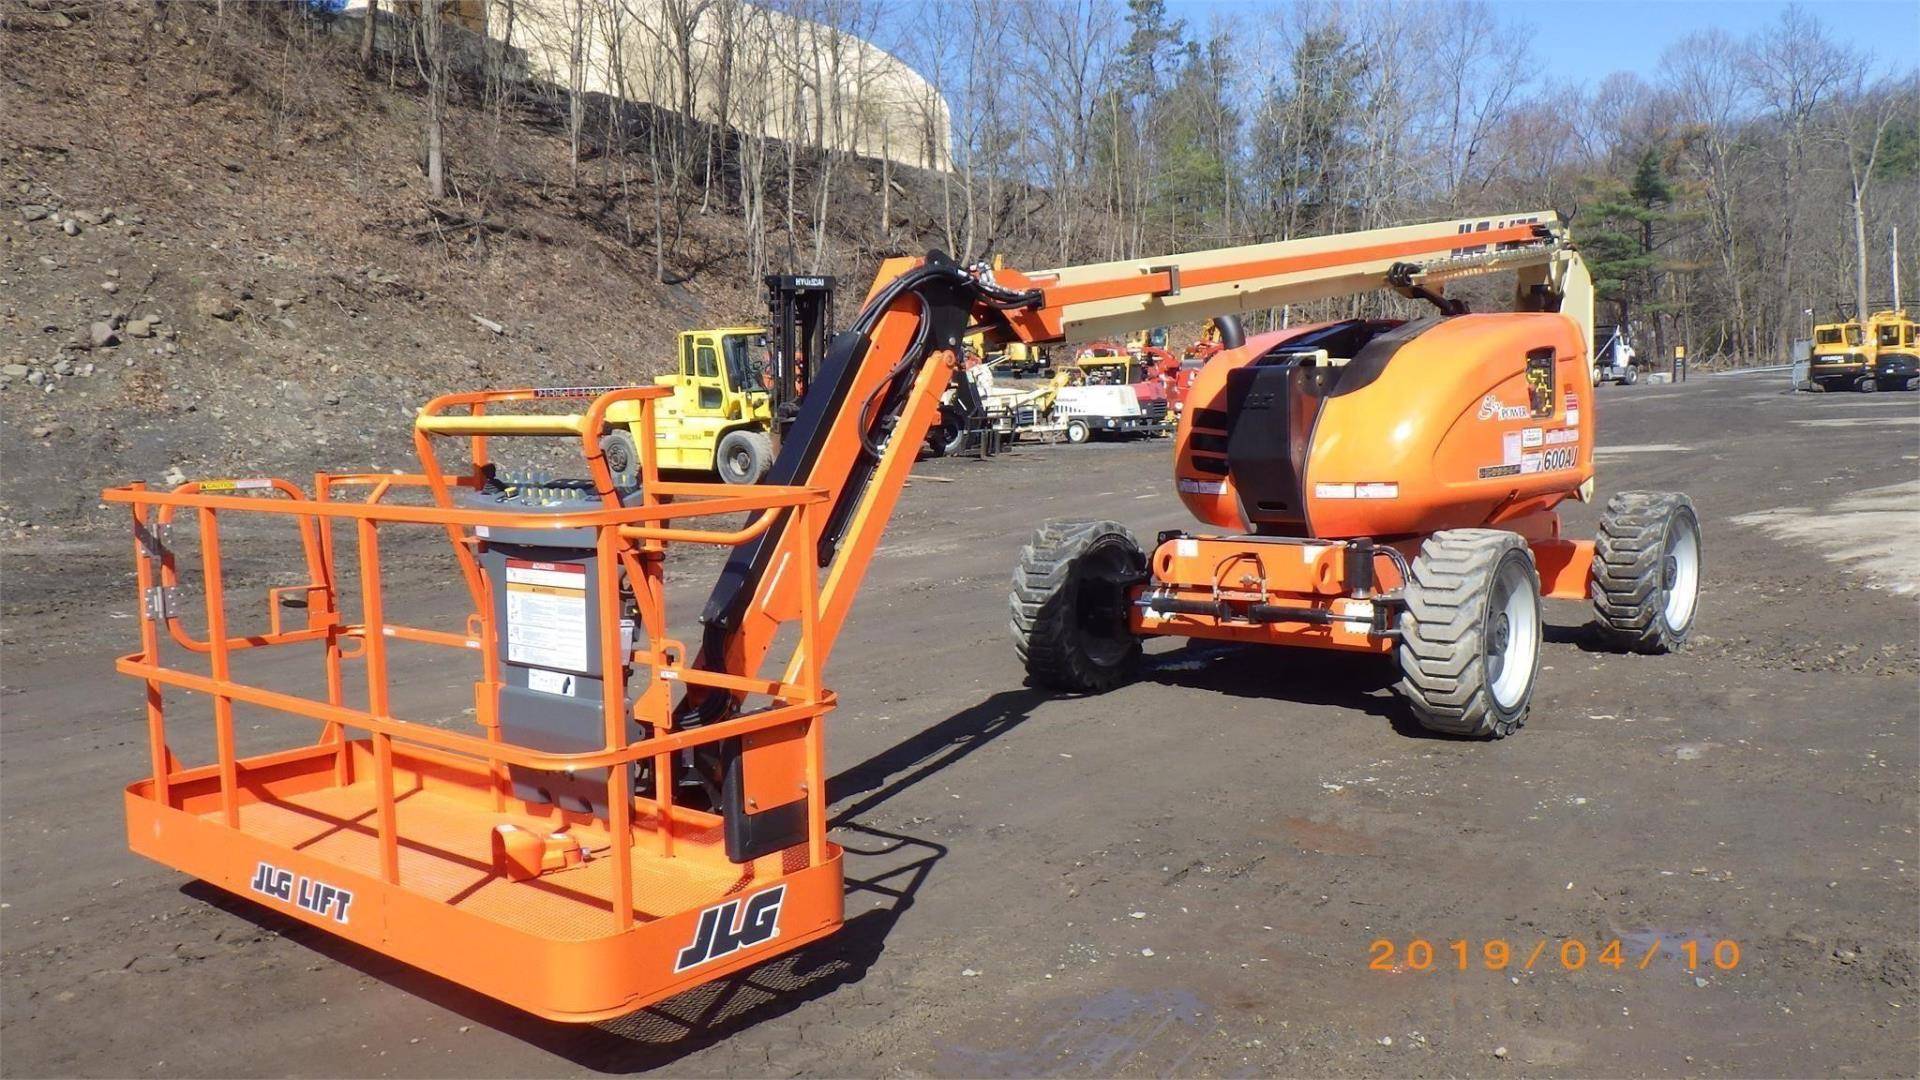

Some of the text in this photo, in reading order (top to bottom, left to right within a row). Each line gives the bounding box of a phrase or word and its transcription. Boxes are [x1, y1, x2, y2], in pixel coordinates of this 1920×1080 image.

[1543, 447, 1578, 471] 600AJ
[252, 863, 352, 923] JLG LIFT
[674, 885, 786, 973] JLG
